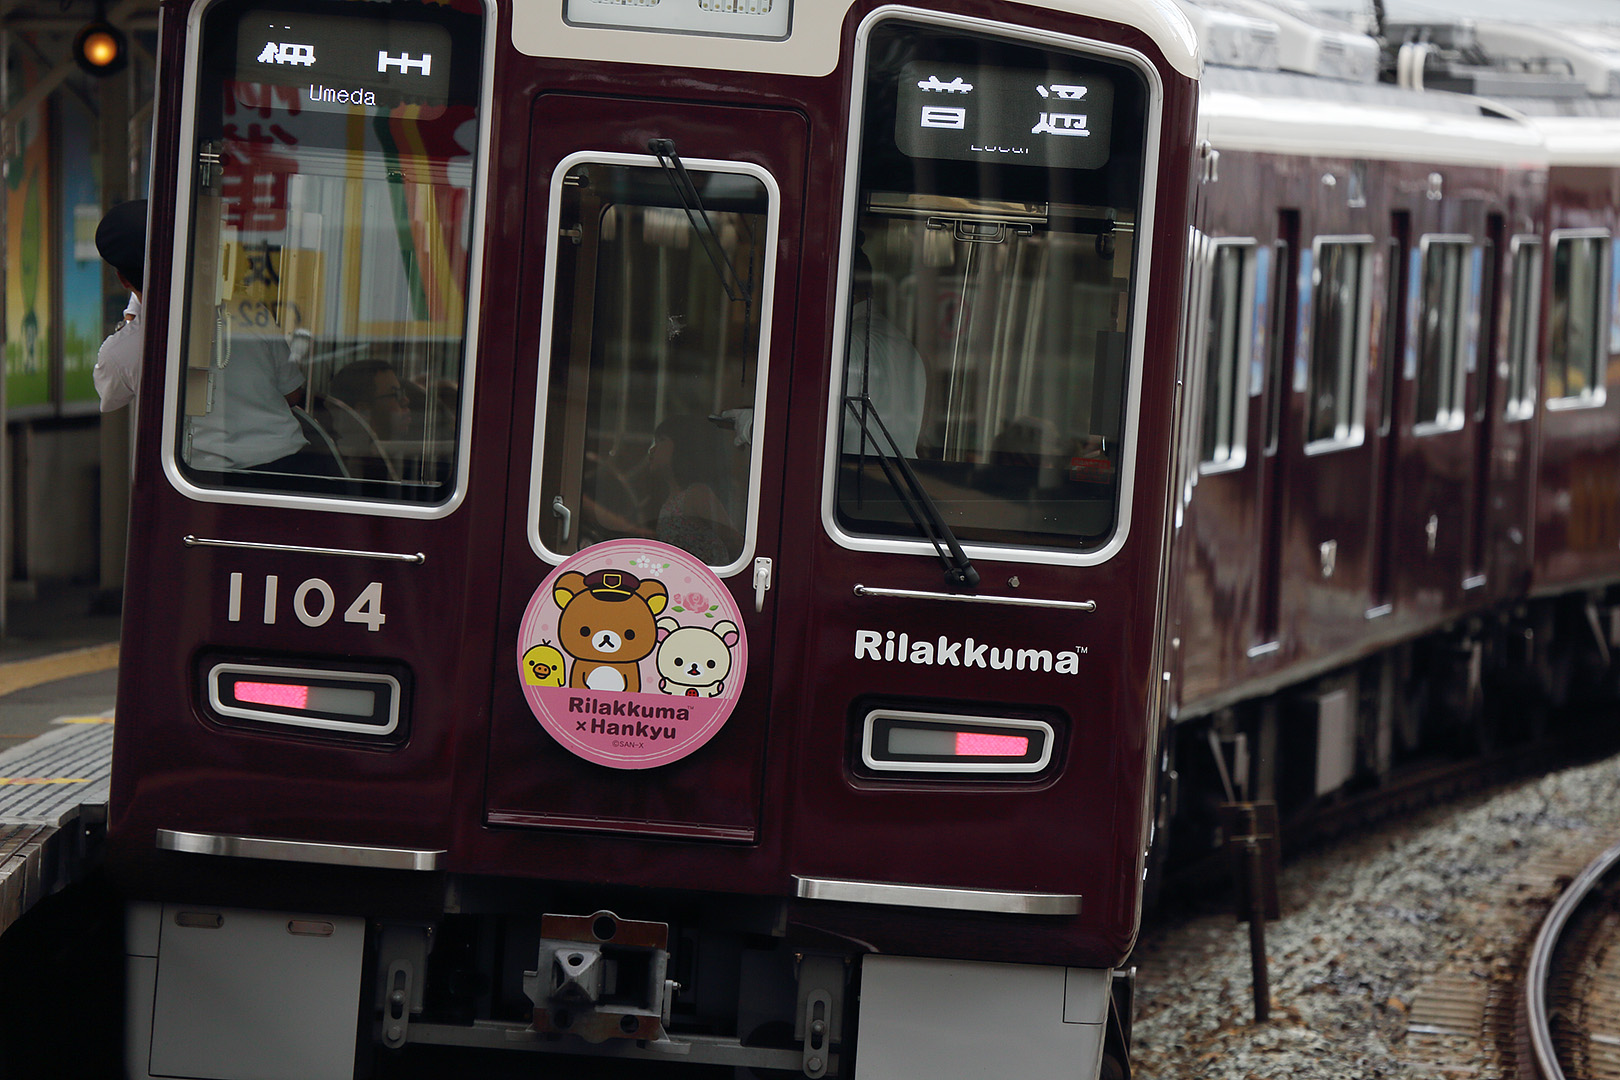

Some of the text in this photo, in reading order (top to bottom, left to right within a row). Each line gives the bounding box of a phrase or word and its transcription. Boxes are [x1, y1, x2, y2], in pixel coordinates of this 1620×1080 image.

[310, 84, 376, 106] Umeda
[228, 572, 386, 632] 1104
[590, 717, 677, 740] Hankyu
